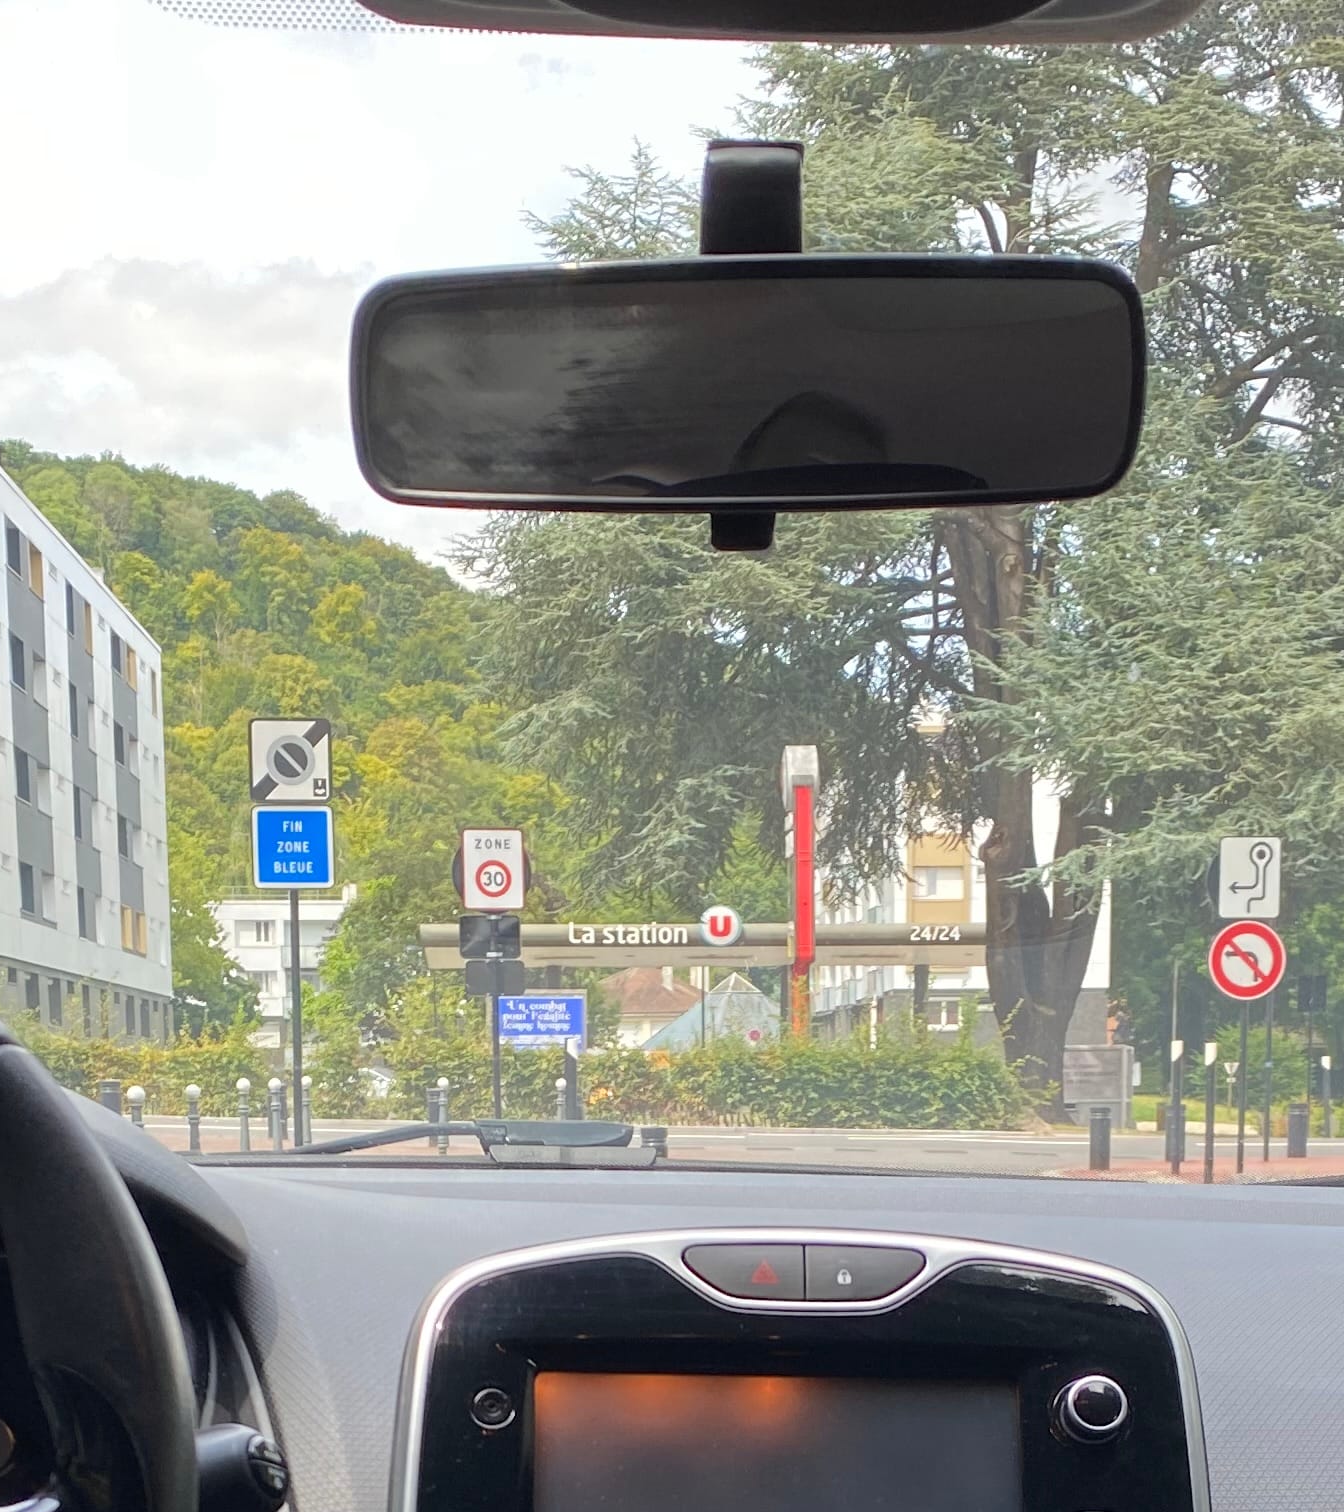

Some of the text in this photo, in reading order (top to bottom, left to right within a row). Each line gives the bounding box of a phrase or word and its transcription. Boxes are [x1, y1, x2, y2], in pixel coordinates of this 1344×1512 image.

[282, 820, 303, 833] FIN
[276, 841, 310, 853] ZONE
[474, 838, 511, 850] ZONE
[273, 861, 314, 874] BLEUE
[483, 871, 505, 887] 30
[568, 915, 732, 945] La station U
[909, 925, 962, 941] 24/24
